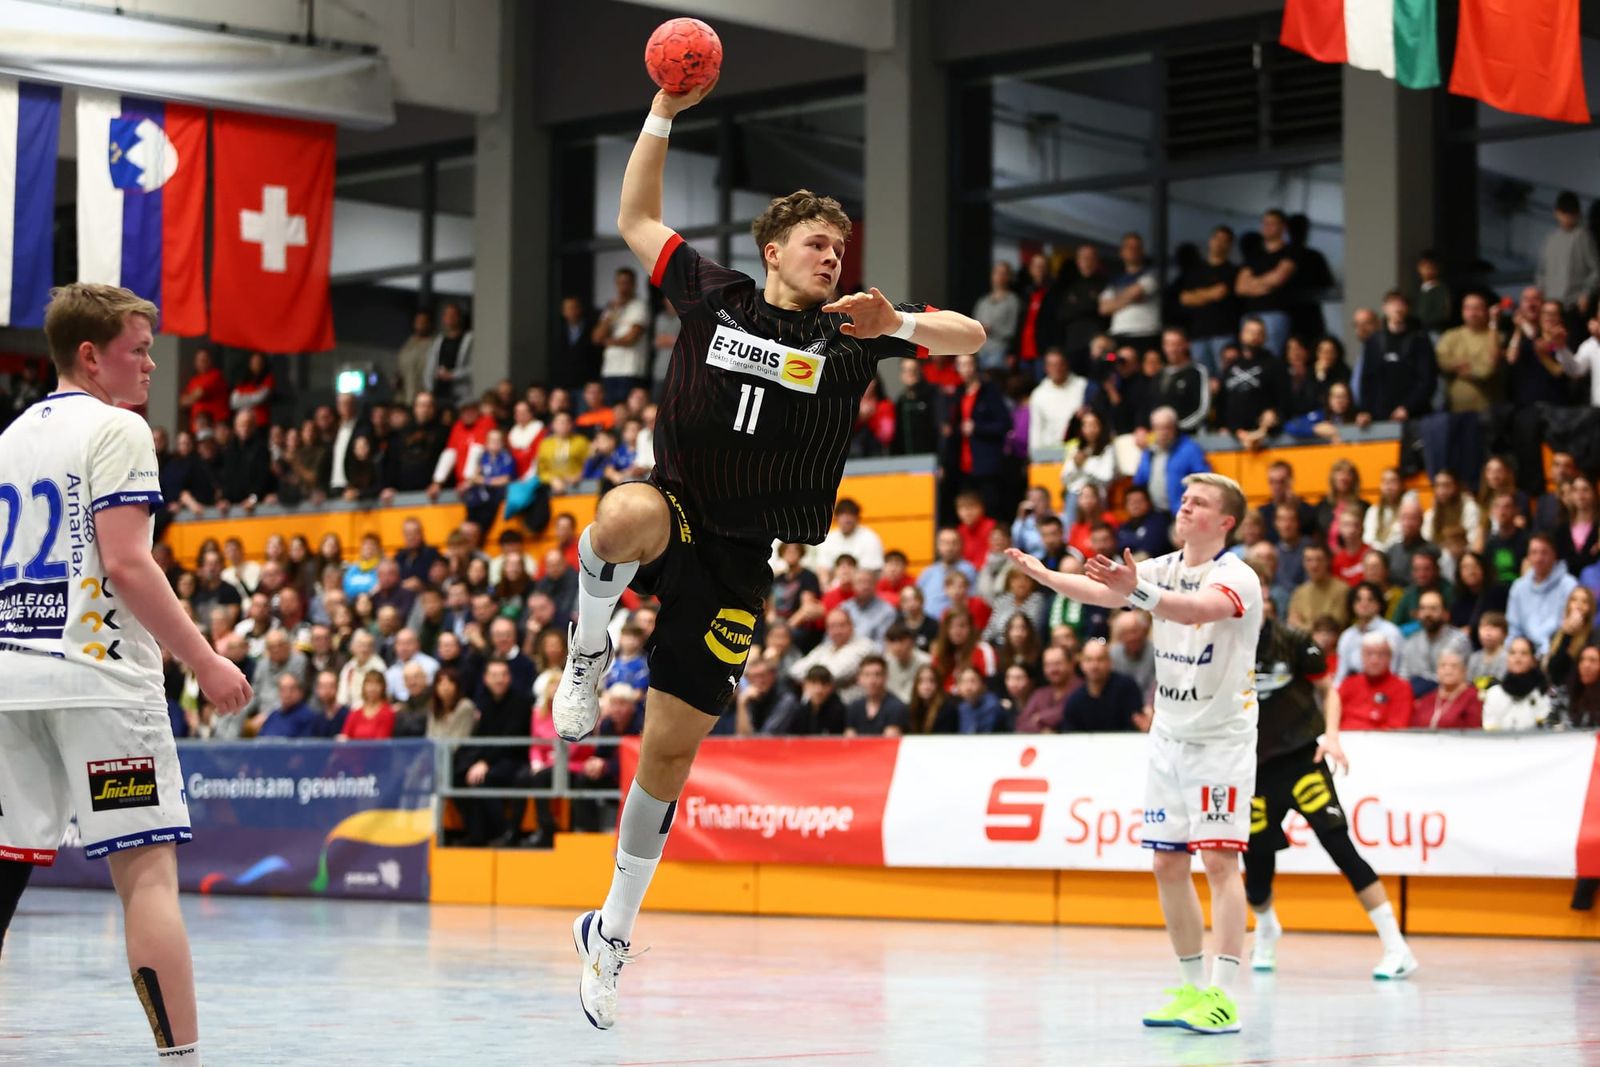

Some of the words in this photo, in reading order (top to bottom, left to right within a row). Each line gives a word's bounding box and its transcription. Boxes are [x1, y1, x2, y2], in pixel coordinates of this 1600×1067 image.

[713, 335, 781, 369] E-ZUBIS
[730, 359, 754, 371] Energie
[757, 365, 779, 377] Digital
[733, 384, 765, 435] 11
[0, 478, 69, 583] 22
[66, 473, 85, 577] Arnarlax
[90, 759, 153, 773] HILTI
[95, 778, 155, 800] Snickers
[188, 772, 294, 799] Gemeinsam
[686, 797, 853, 838] Finanzgruppe
[1206, 813, 1231, 822] KFC
[1353, 797, 1446, 862] Cup
[117, 838, 145, 850] Kempa
[152, 833, 175, 842] Kempa
[180, 831, 193, 840] Kemp
[0, 849, 25, 860] Kempa
